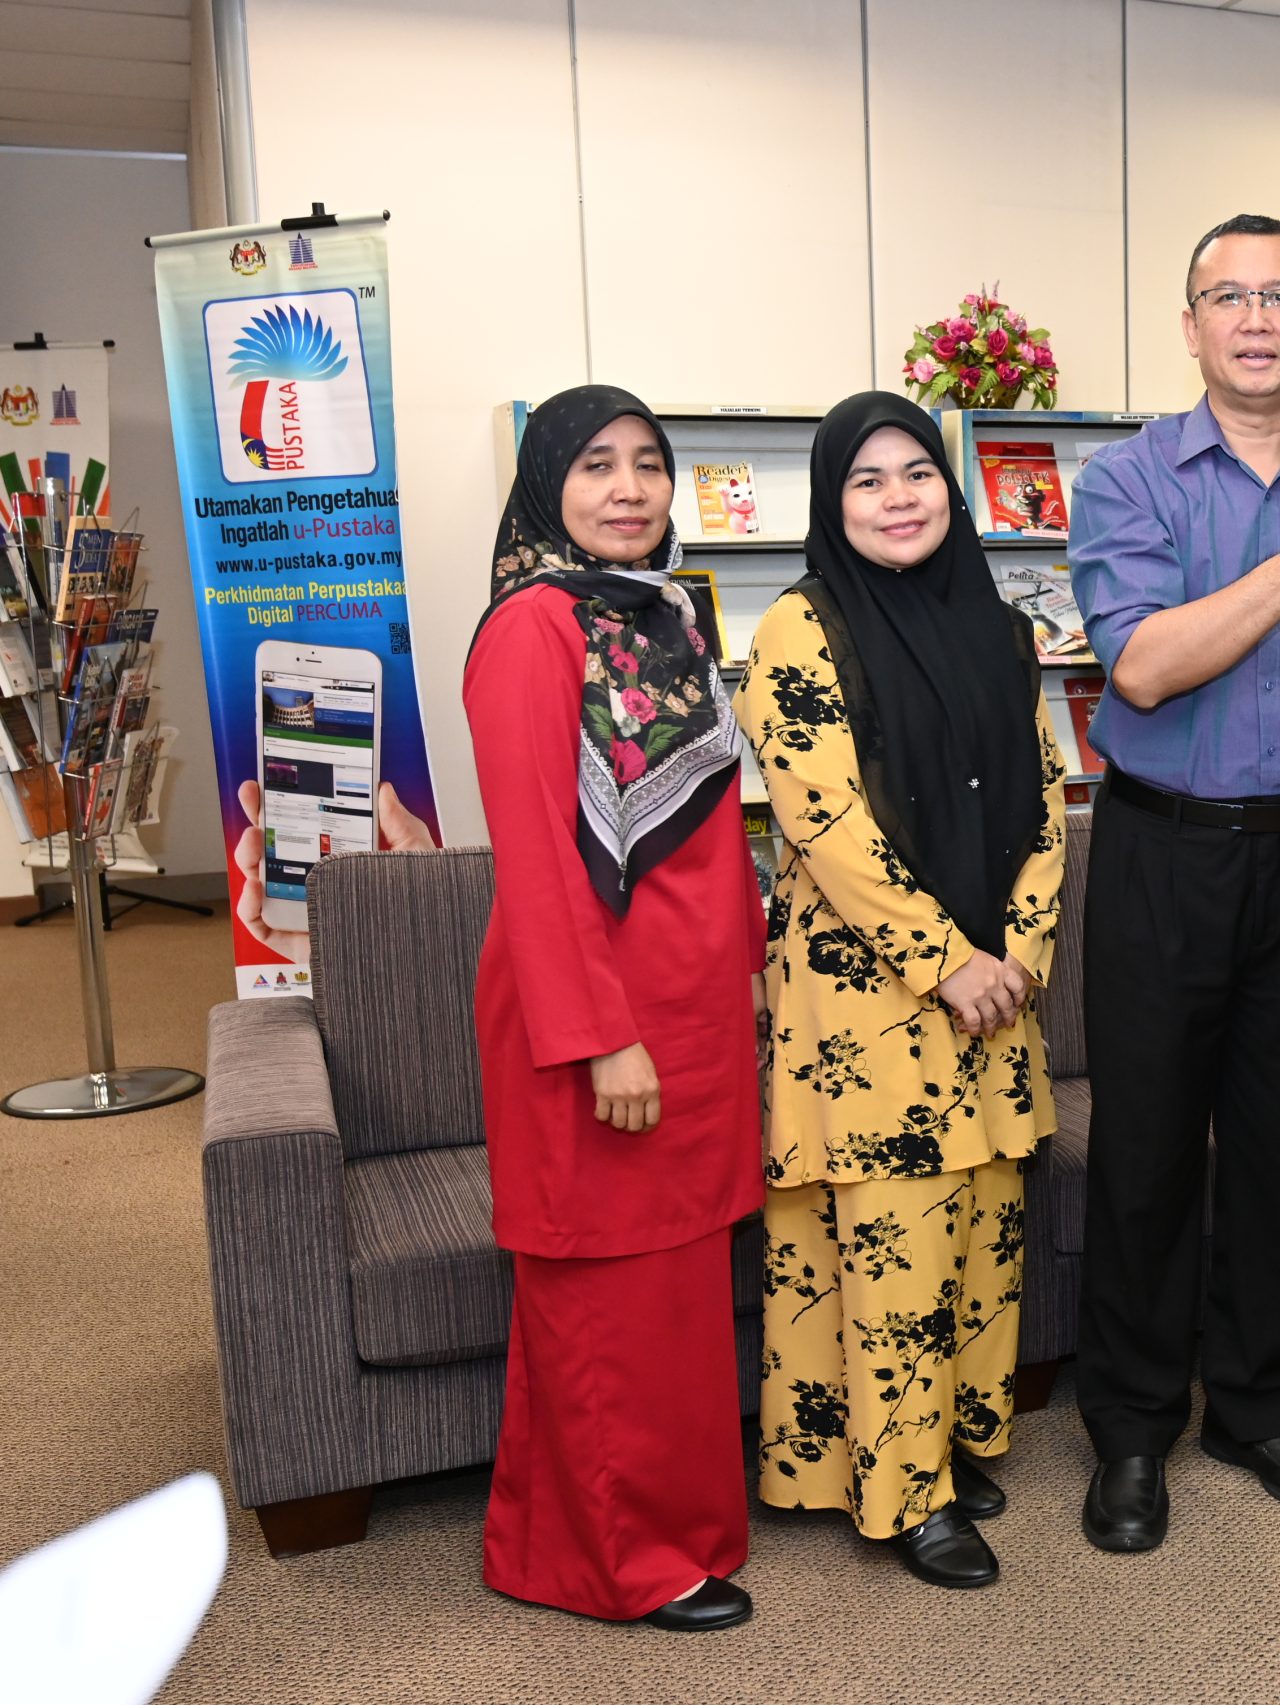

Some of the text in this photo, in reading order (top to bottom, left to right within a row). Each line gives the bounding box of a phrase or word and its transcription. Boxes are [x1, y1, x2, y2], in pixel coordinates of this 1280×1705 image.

[359, 286, 376, 299] TM
[279, 381, 304, 470] PUSTAKA
[697, 462, 748, 476] Reader's
[195, 494, 283, 519] Utamakan
[221, 514, 396, 547] Ingatlah u-Pustaka
[216, 550, 402, 574] www.u-pustaka.gov.my
[1008, 571, 1035, 580] Pelita
[204, 578, 408, 605] Perkhidmatan Perpustakaa
[247, 602, 383, 627] Digital PERCUMA
